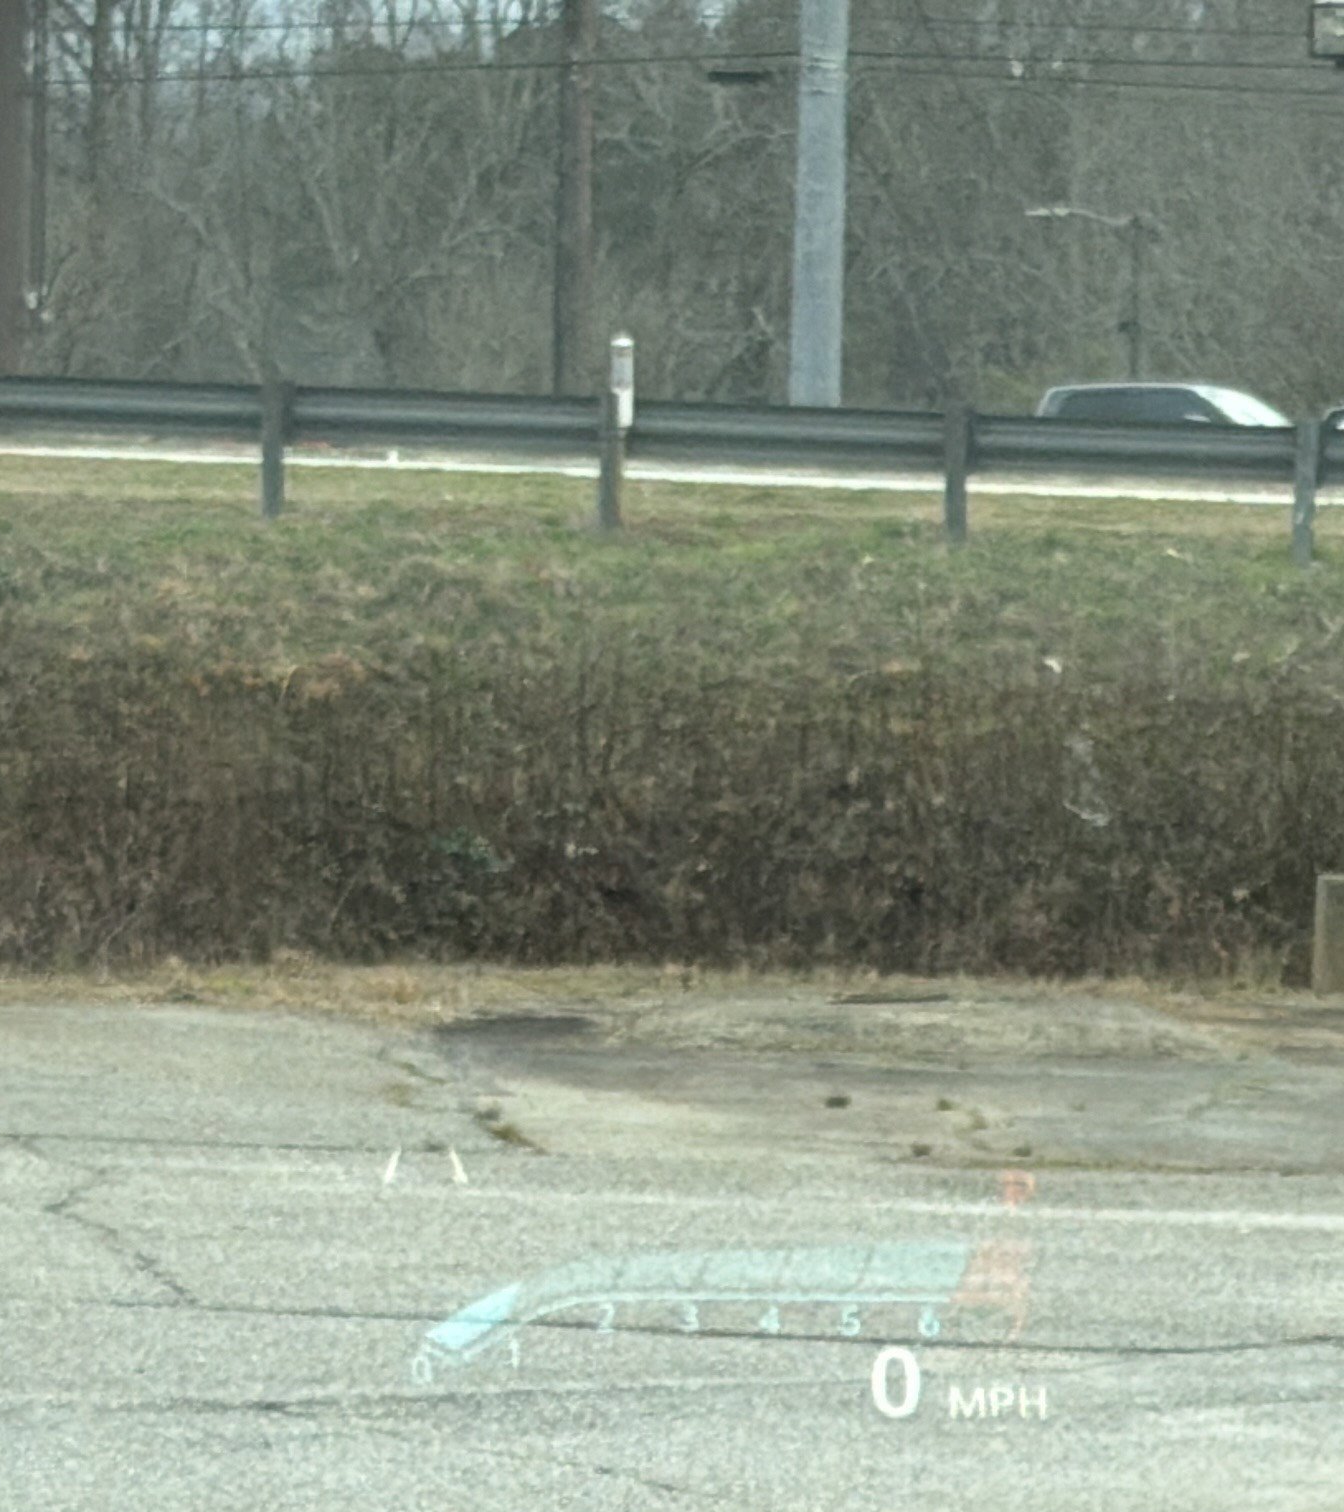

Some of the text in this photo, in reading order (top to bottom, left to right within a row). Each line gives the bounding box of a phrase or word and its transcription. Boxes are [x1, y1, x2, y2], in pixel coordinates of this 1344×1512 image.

[597, 1303, 616, 1334] 2
[680, 1303, 700, 1332] 3
[759, 1305, 782, 1334] 4
[838, 1304, 861, 1337] 5
[918, 1306, 941, 1338] 6
[871, 1346, 1048, 1421] 0 MPH
